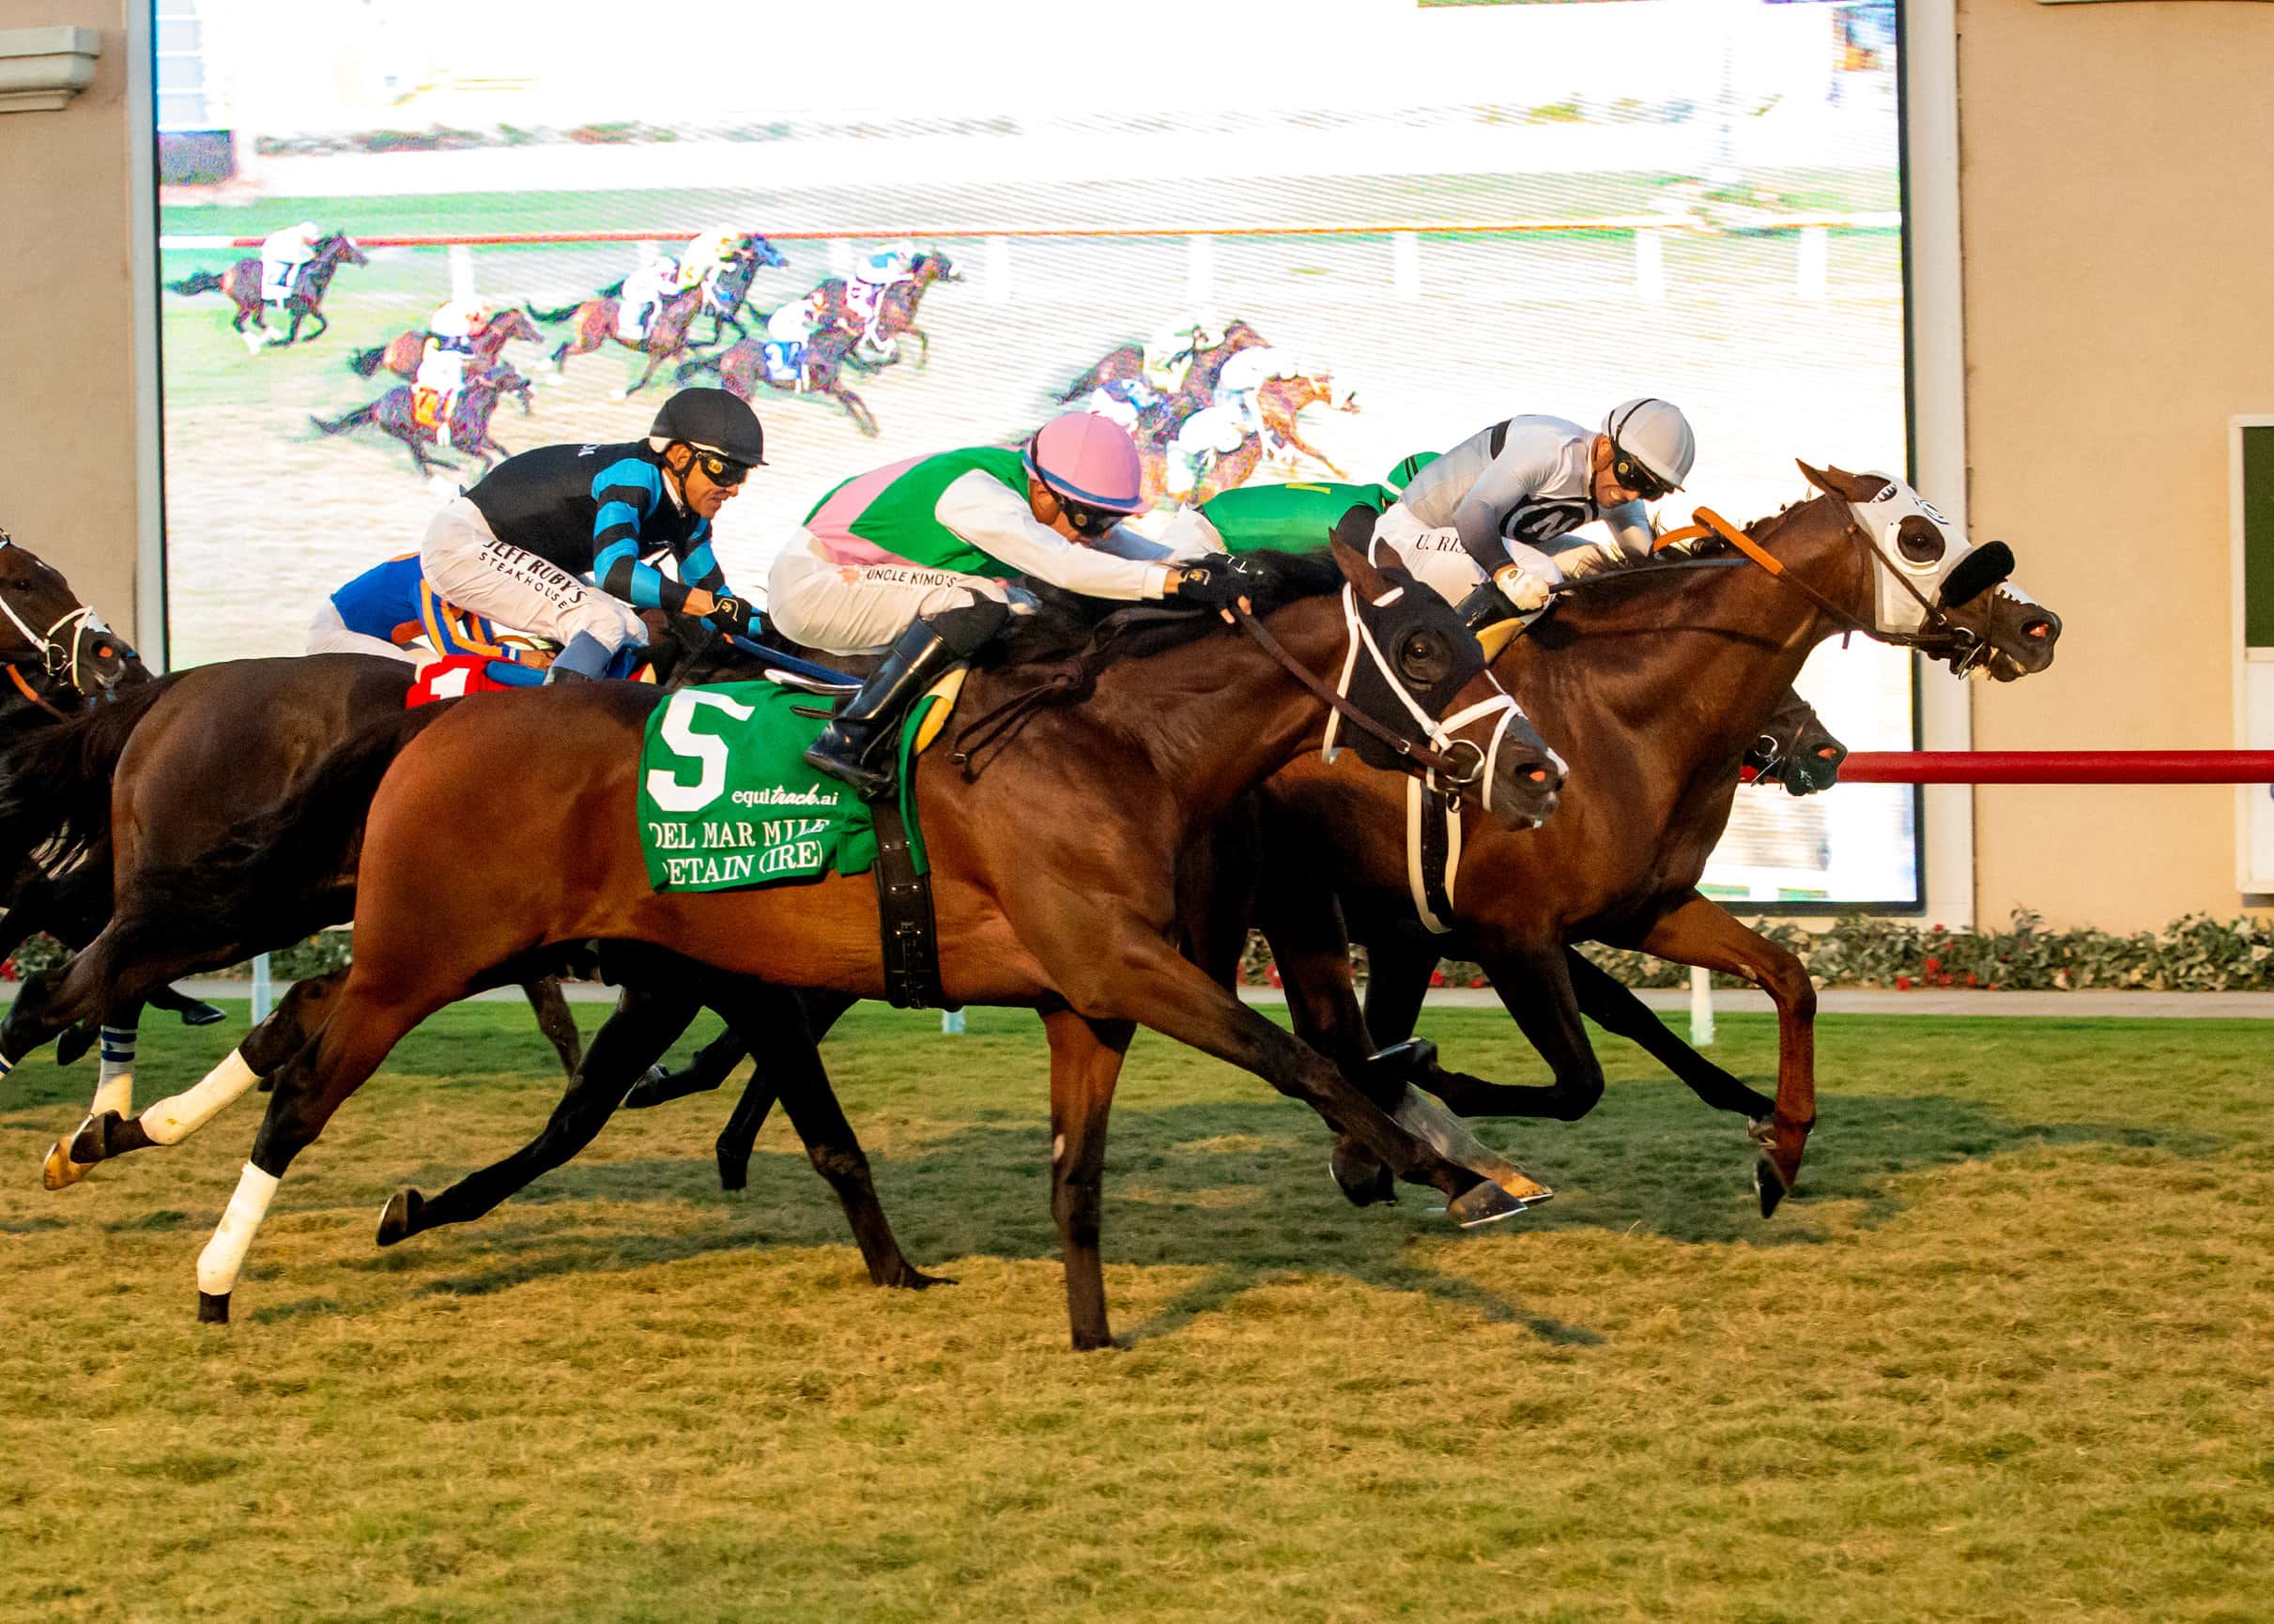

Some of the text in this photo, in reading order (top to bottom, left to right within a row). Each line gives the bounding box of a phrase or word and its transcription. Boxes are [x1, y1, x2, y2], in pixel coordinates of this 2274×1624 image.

[1416, 534, 1429, 550] U.
[479, 552, 567, 609] STEAKHOUSE
[483, 541, 588, 604] JEFF RUBY'S
[867, 569, 957, 588] UNCLE KIMO'S
[647, 688, 755, 812] 5
[701, 821, 756, 848] MAR
[761, 819, 830, 847] MILE
[662, 840, 822, 884] ETAIN (IRE)
